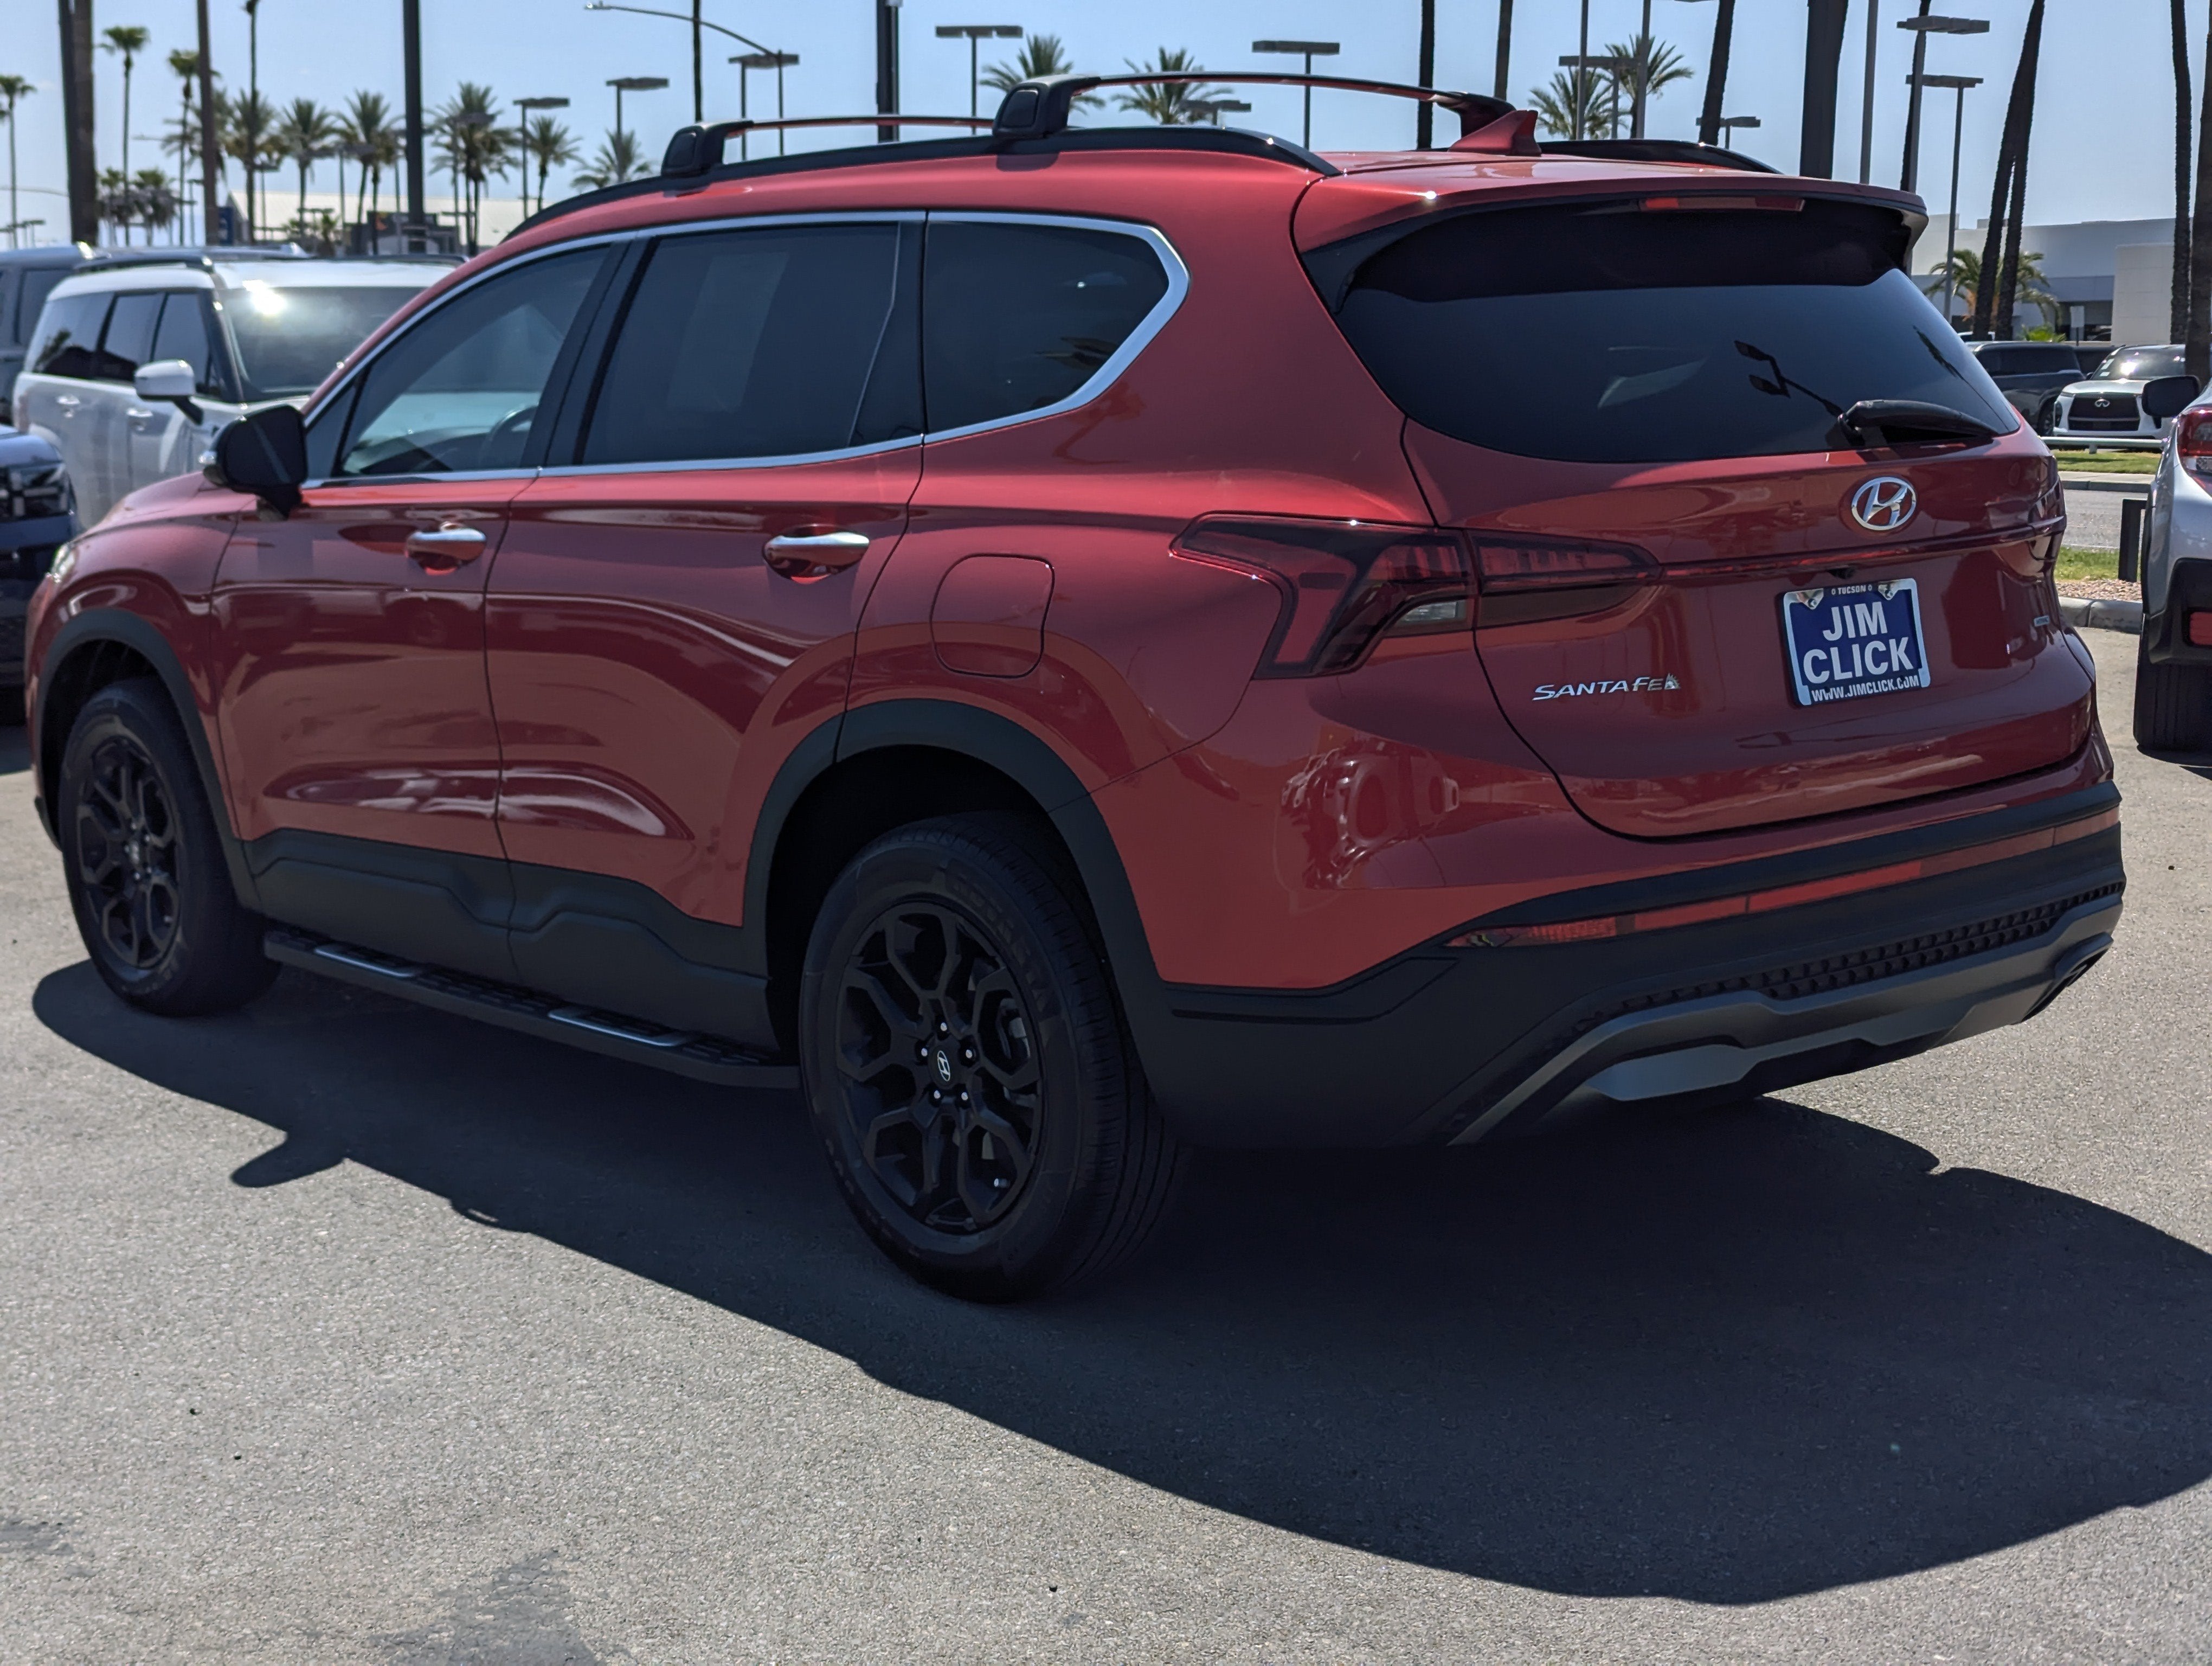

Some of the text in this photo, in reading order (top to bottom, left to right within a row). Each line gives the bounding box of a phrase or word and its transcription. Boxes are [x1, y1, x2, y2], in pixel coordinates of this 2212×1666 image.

[1837, 585, 1866, 595] TUCSON
[1823, 601, 1888, 641] JIM
[1803, 637, 1914, 684] CLICK
[1811, 675, 1919, 702] WWW.JIMCLICK.COM
